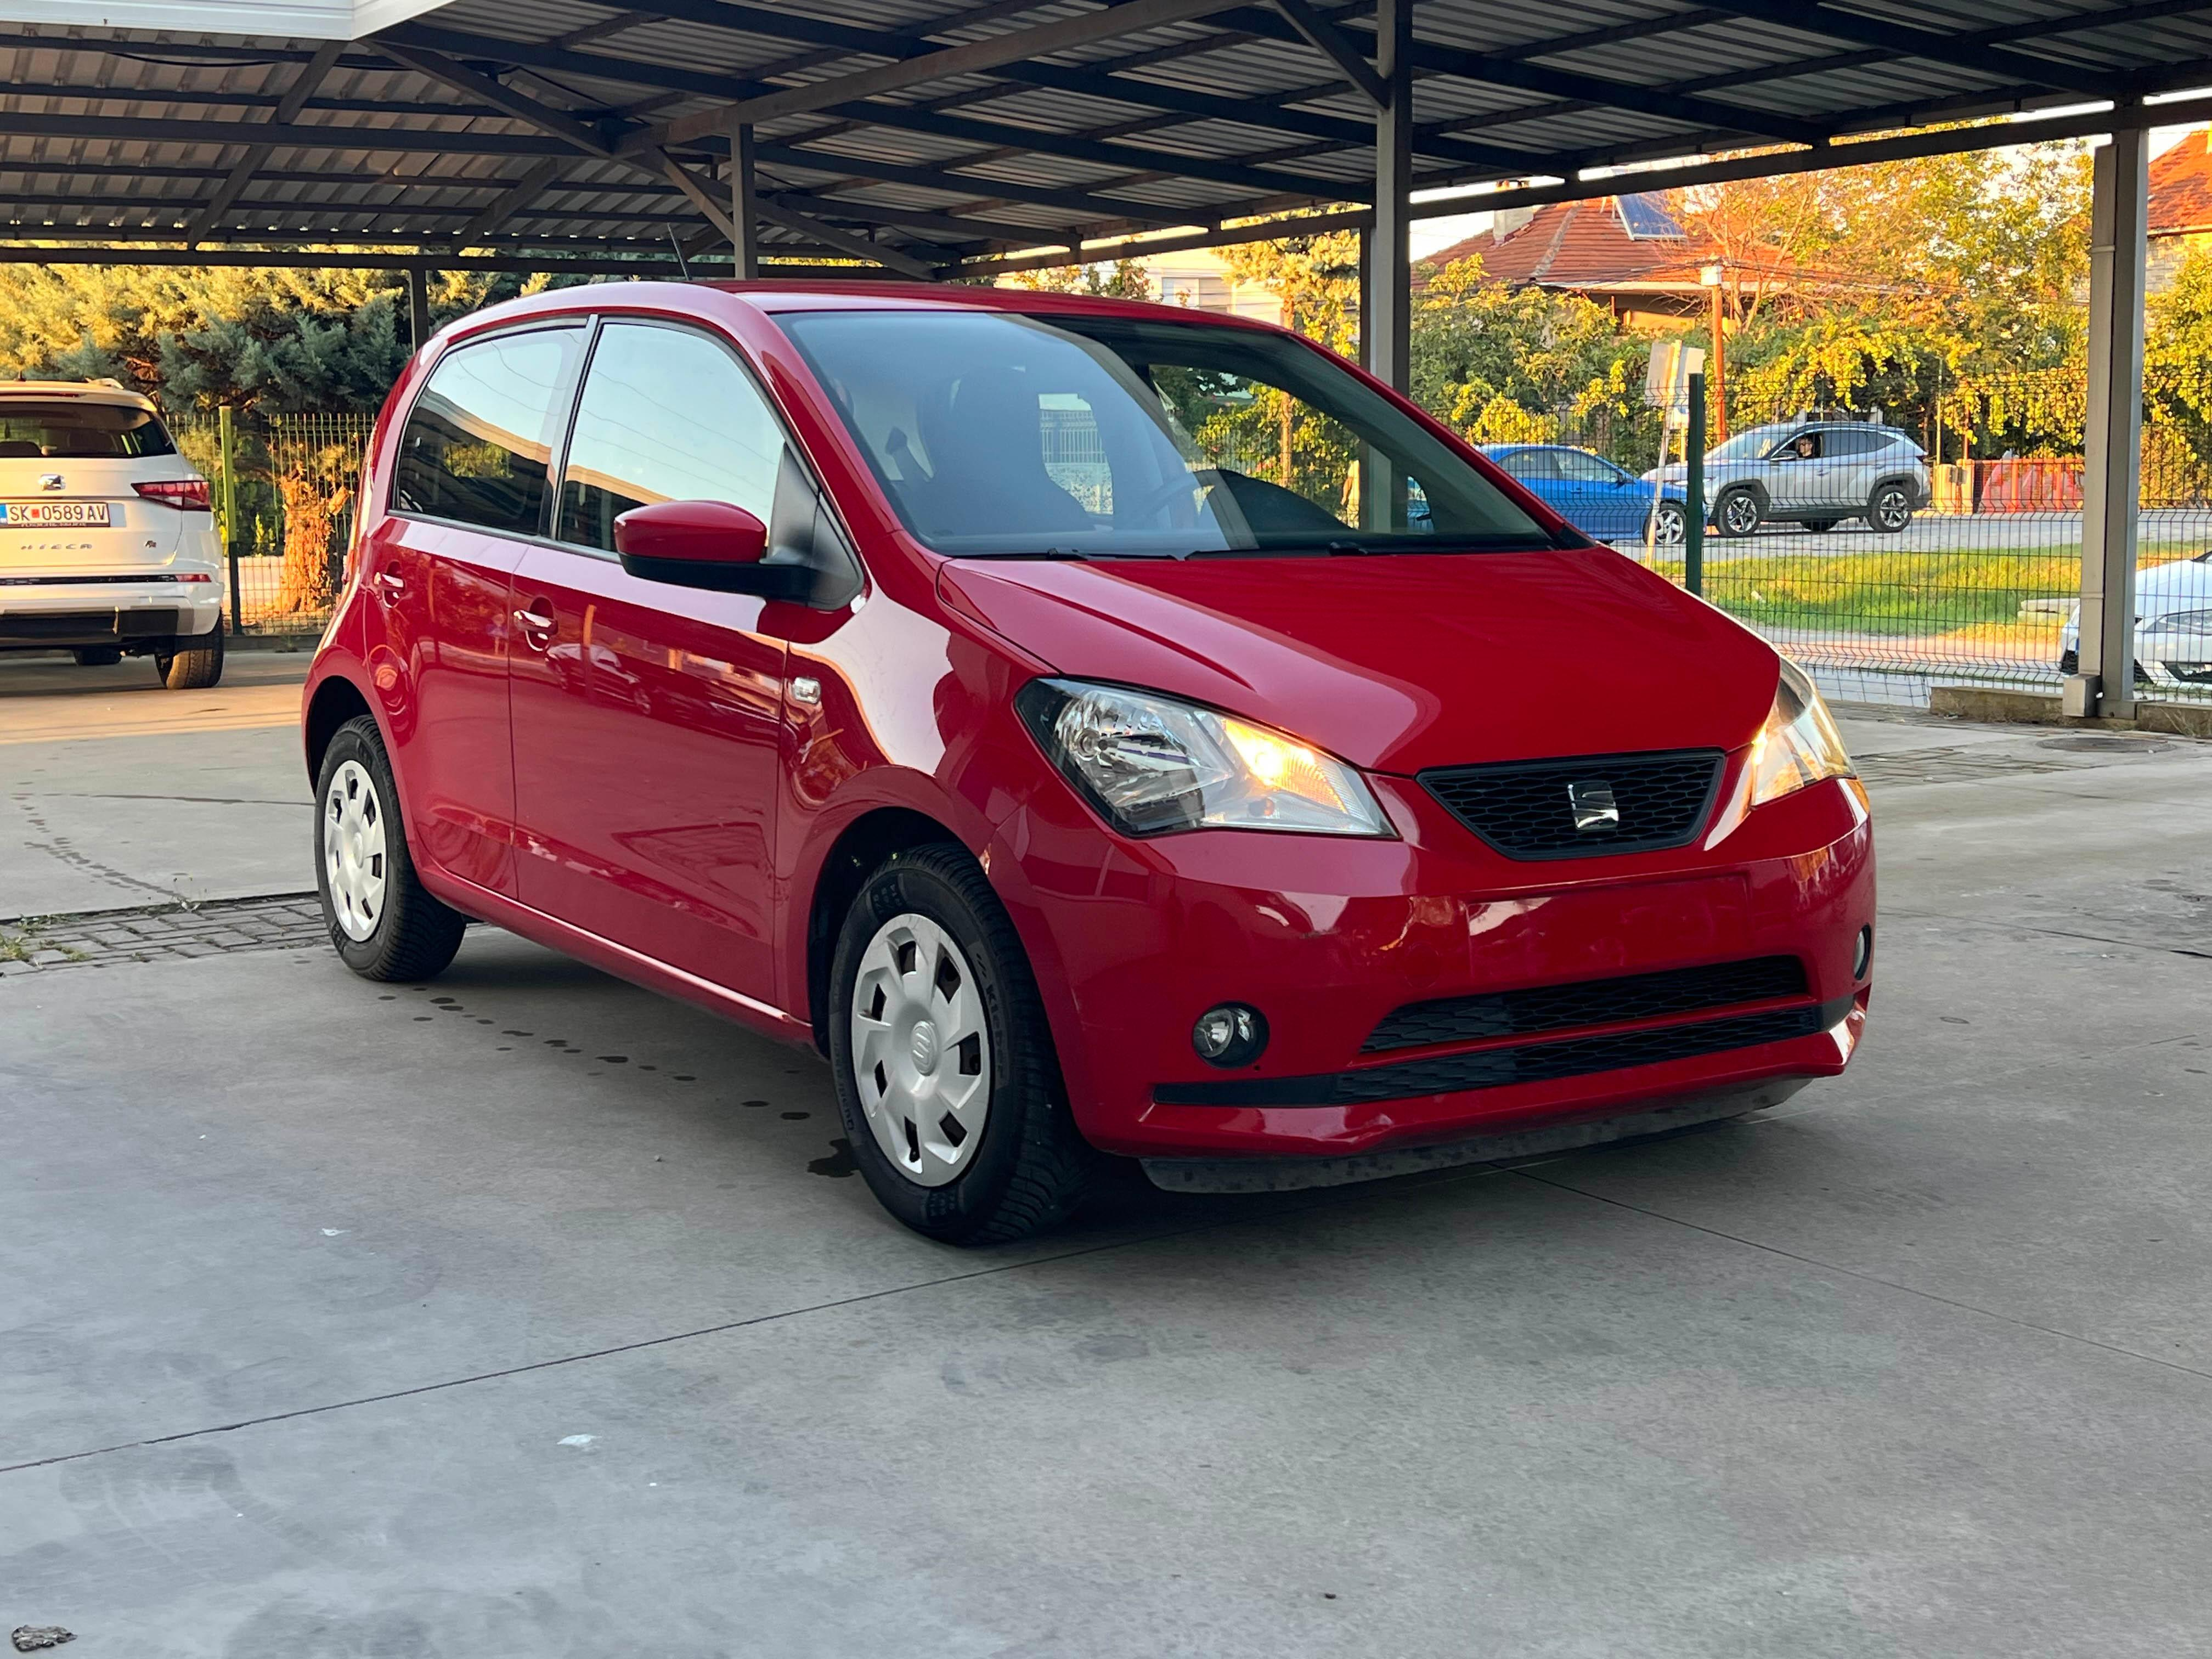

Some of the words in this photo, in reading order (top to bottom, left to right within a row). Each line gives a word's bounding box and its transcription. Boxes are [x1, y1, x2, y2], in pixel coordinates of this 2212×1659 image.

[10, 506, 30, 521] SK
[42, 505, 82, 521] 0589
[87, 505, 105, 520] AV
